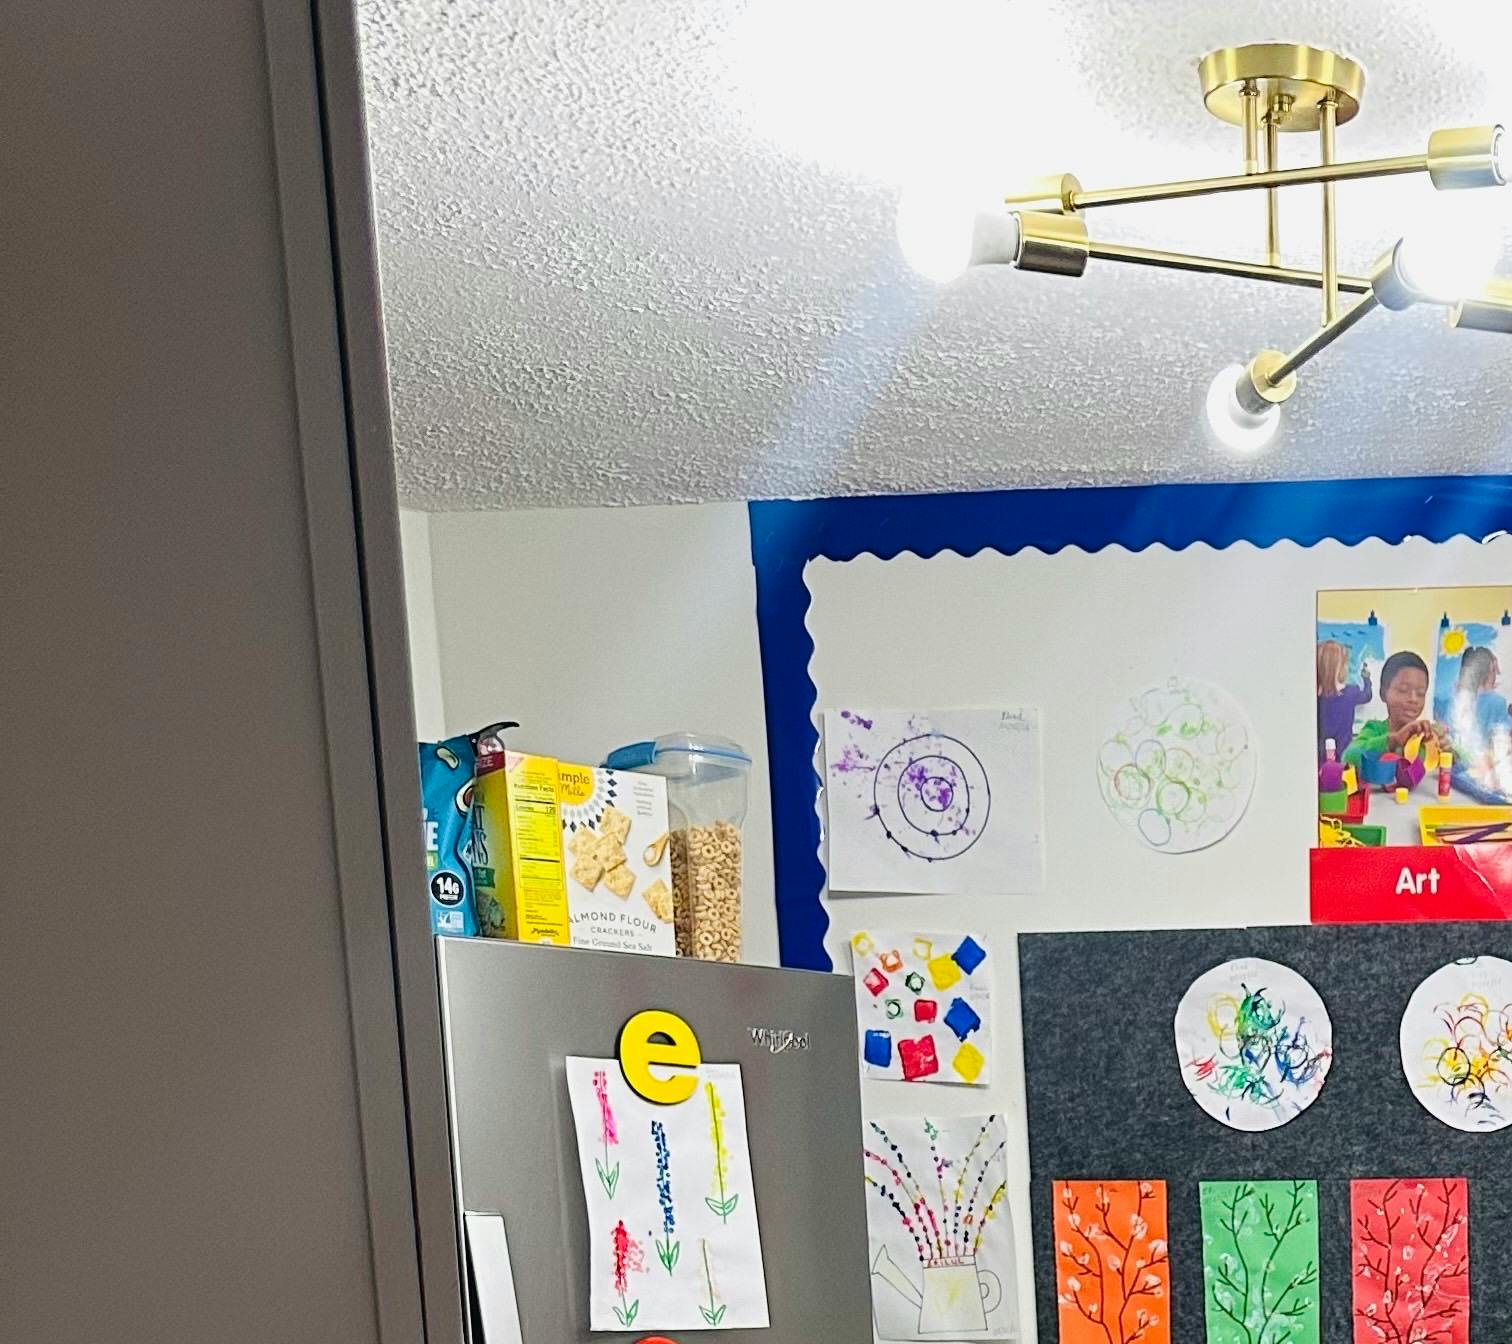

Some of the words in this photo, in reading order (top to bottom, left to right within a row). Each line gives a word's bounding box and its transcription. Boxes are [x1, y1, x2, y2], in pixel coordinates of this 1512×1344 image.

[1395, 866, 1440, 895] Art
[590, 926, 635, 937] CRACKERS
[620, 914, 657, 933] FLOUR
[620, 1009, 702, 1105] e
